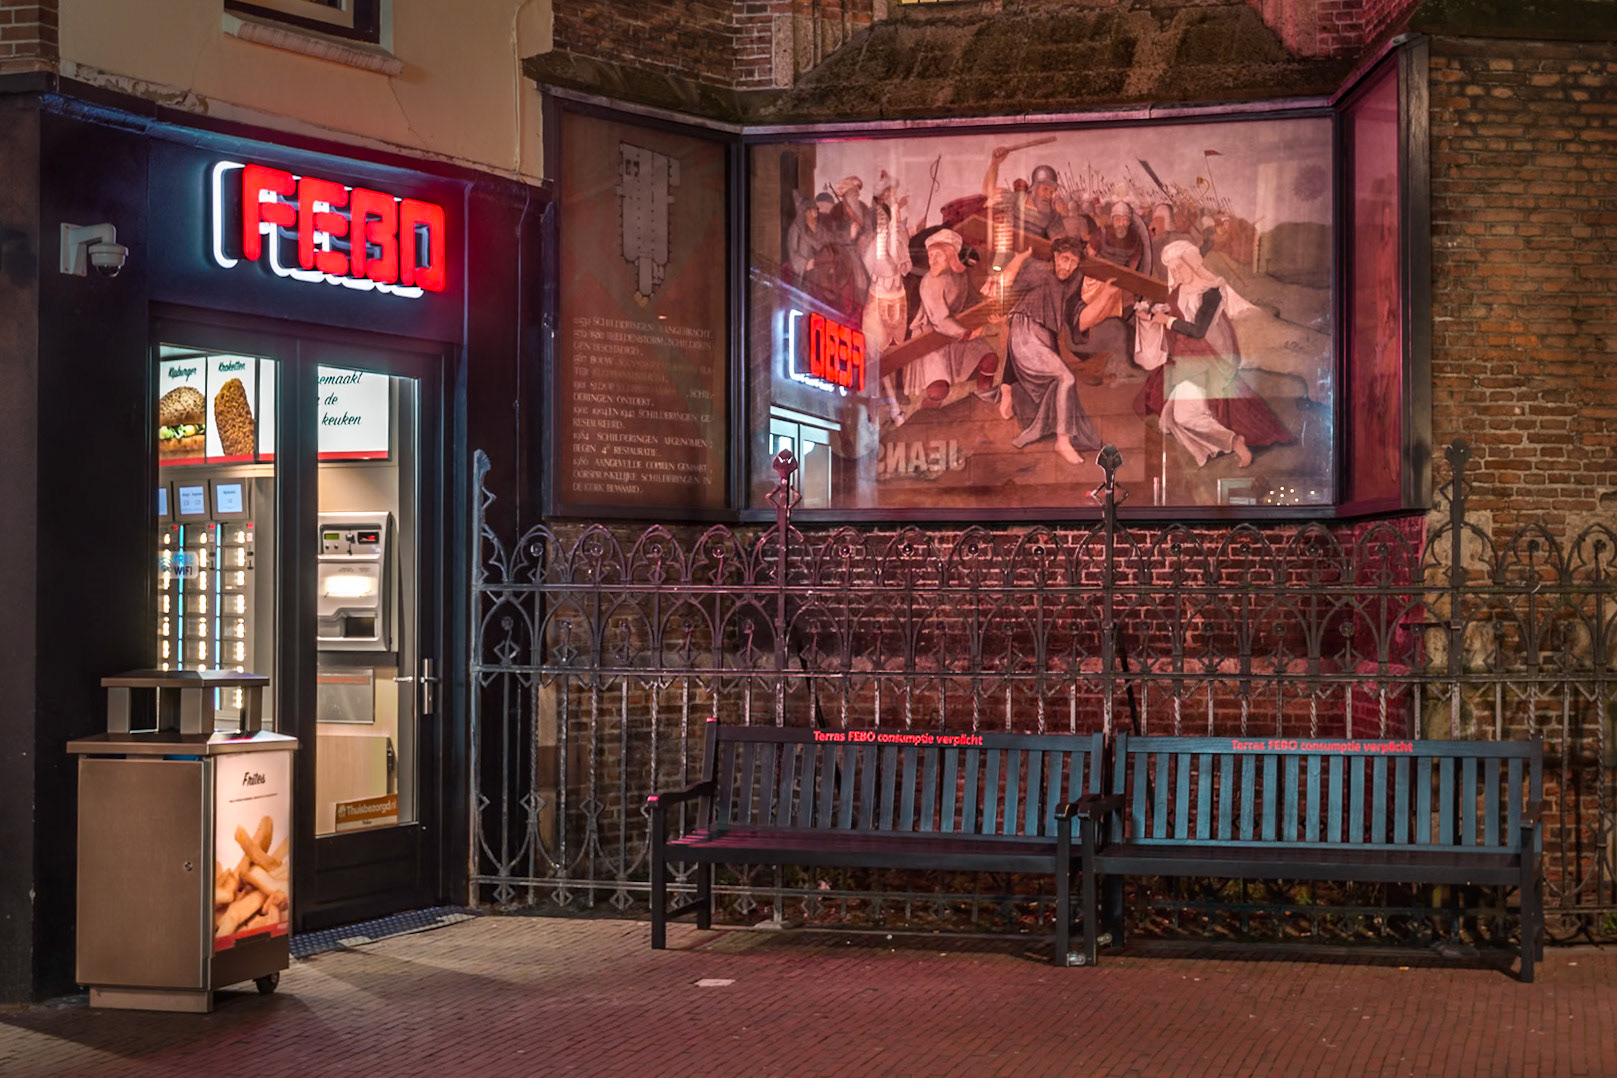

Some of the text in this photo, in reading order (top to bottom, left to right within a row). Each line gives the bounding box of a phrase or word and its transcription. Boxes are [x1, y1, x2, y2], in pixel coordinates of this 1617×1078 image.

[242, 163, 446, 293] FEBO
[218, 361, 246, 372] Kroketten
[318, 371, 364, 385] emaakt
[324, 392, 339, 405] de
[322, 411, 362, 426] keuken
[596, 431, 659, 444] SCHILDERINGEN
[813, 730, 983, 747] Terras FEBO consumptie verplicht
[1231, 739, 1413, 754] Terras FEBO consumptie verplicht
[242, 771, 266, 786] Frites
